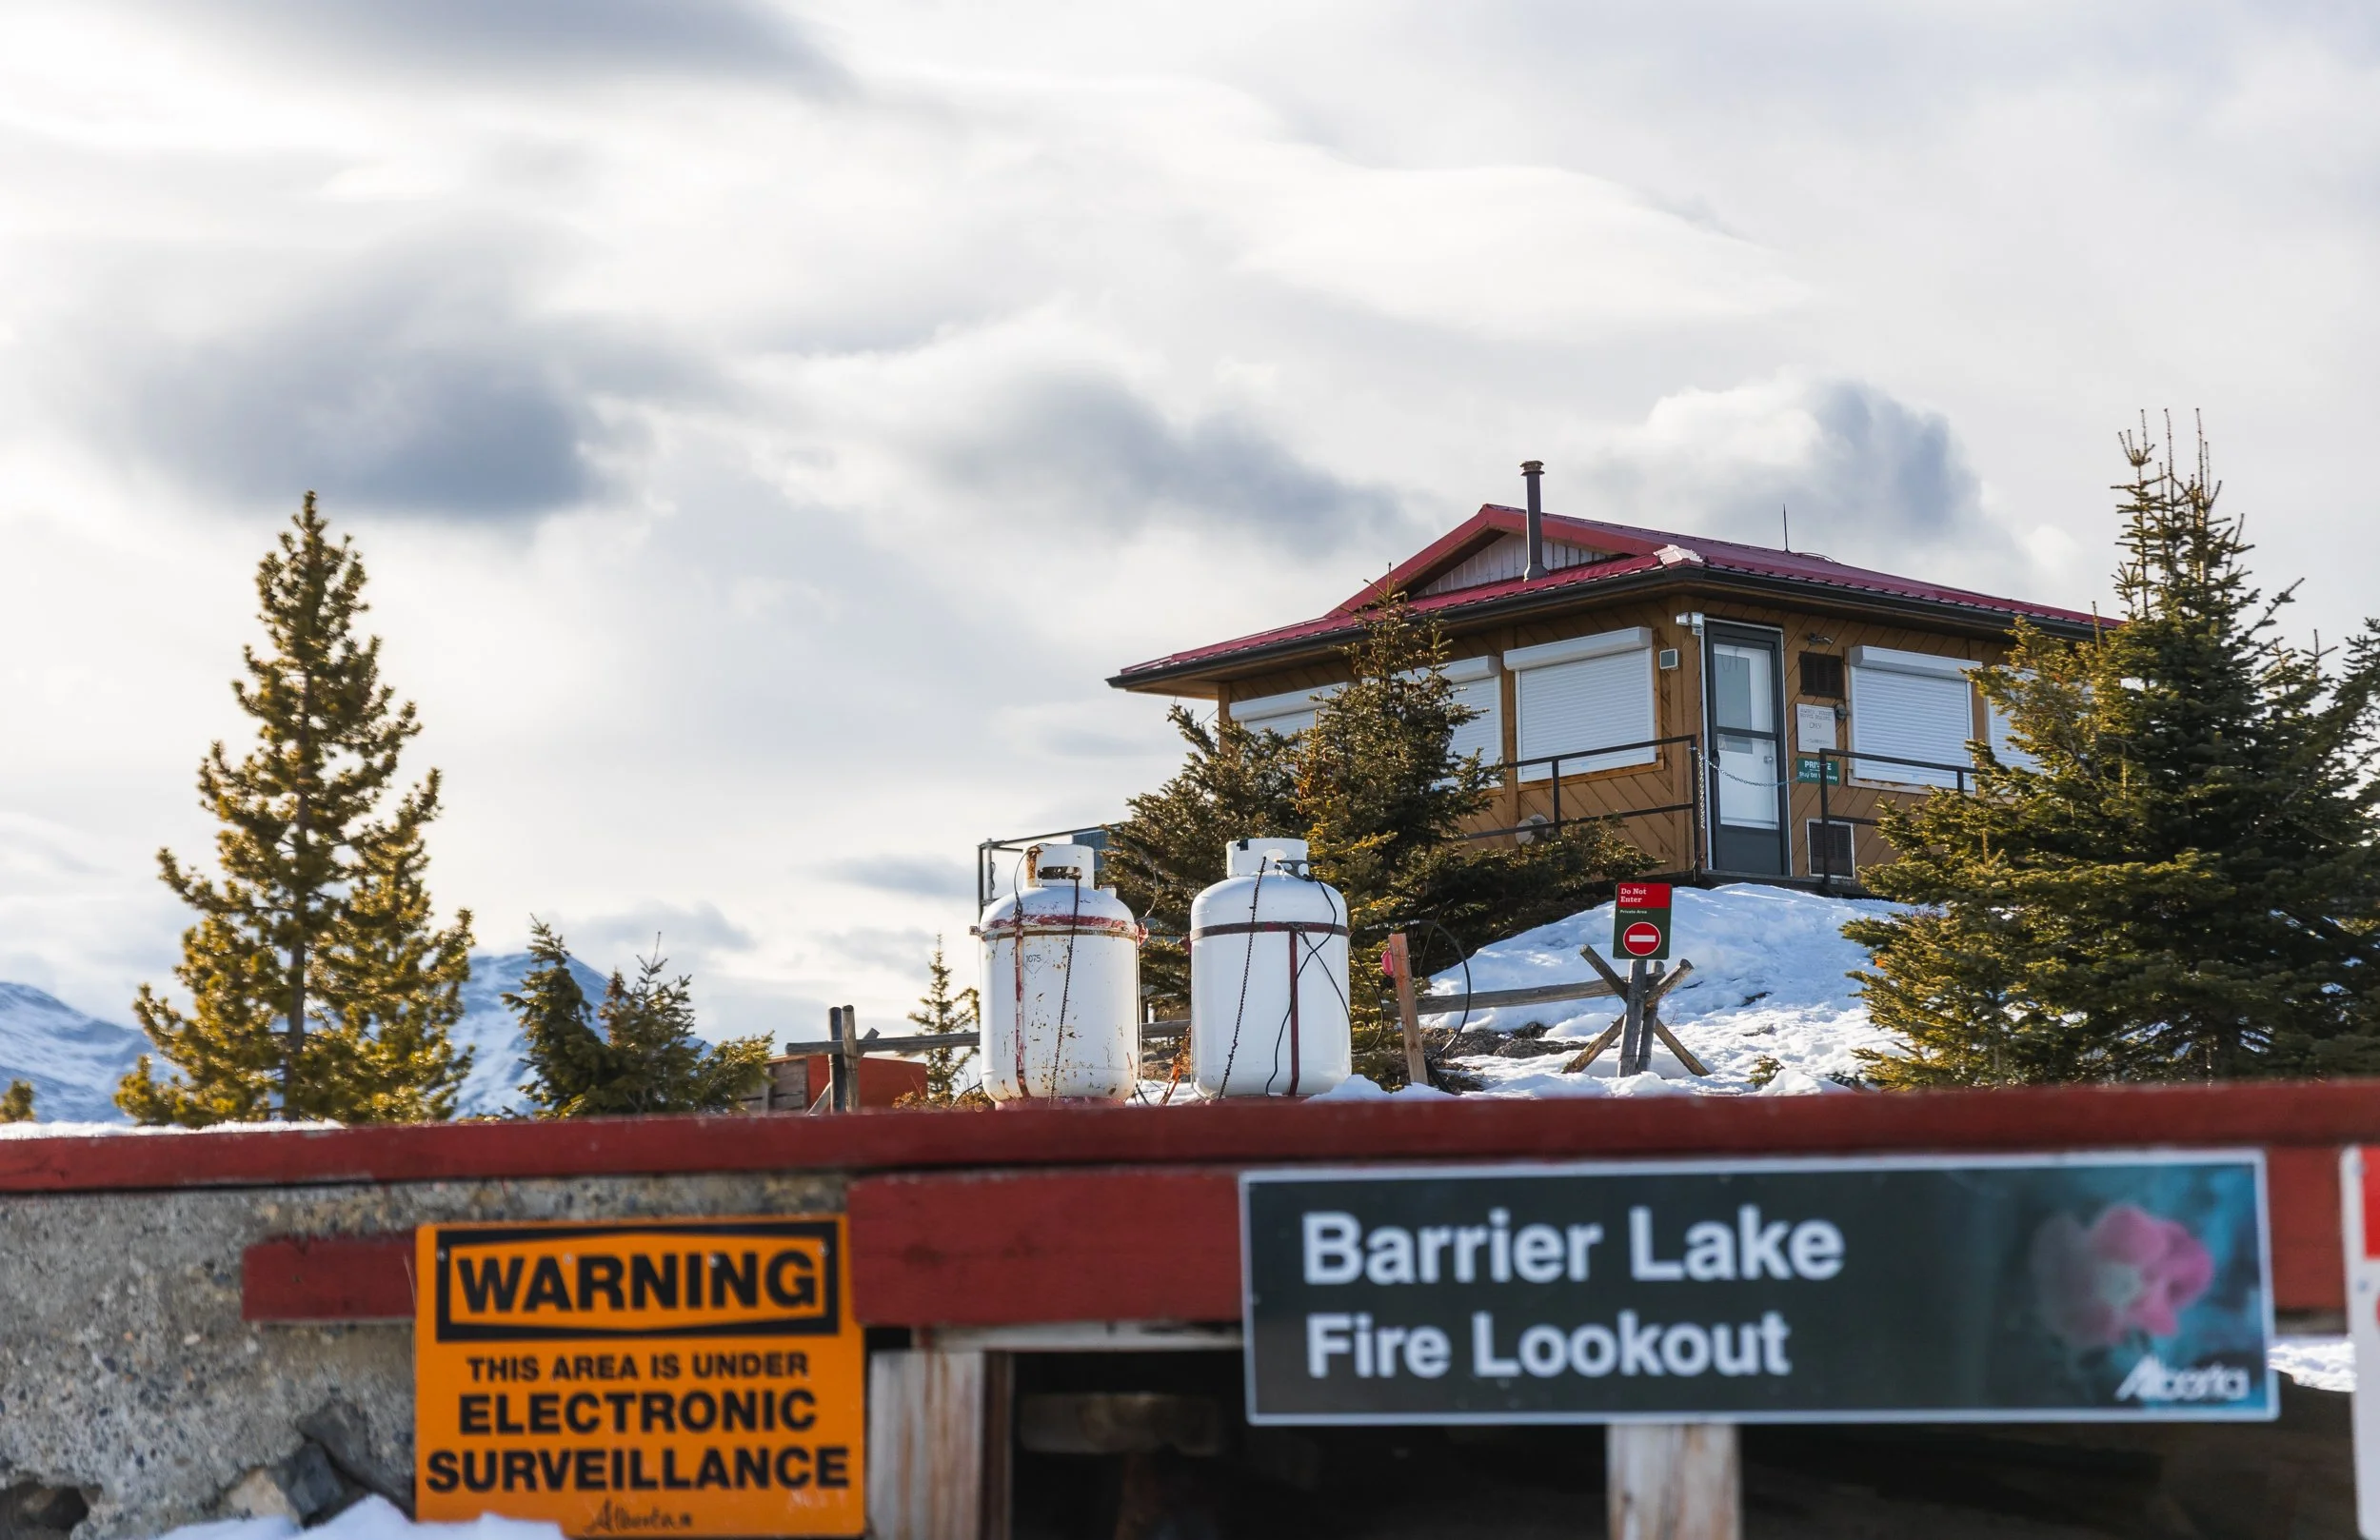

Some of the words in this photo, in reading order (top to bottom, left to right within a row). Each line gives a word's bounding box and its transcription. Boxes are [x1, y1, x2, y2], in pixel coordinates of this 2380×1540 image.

[1805, 760, 1832, 771] PRIVE
[1025, 954, 1041, 962] 1075
[1301, 1208, 1604, 1285] Barrier
[1629, 1204, 1845, 1281] Lake
[457, 1250, 817, 1313] WARNING
[466, 1354, 540, 1382] THIS
[551, 1352, 639, 1381] AREA
[651, 1352, 681, 1379] IS
[693, 1351, 809, 1378] UNDER
[1307, 1312, 1451, 1379] Fire
[1472, 1309, 1792, 1378] Lookout
[458, 1388, 818, 1436] ELECTRONIC
[426, 1446, 850, 1493] SURVEILLANCE
